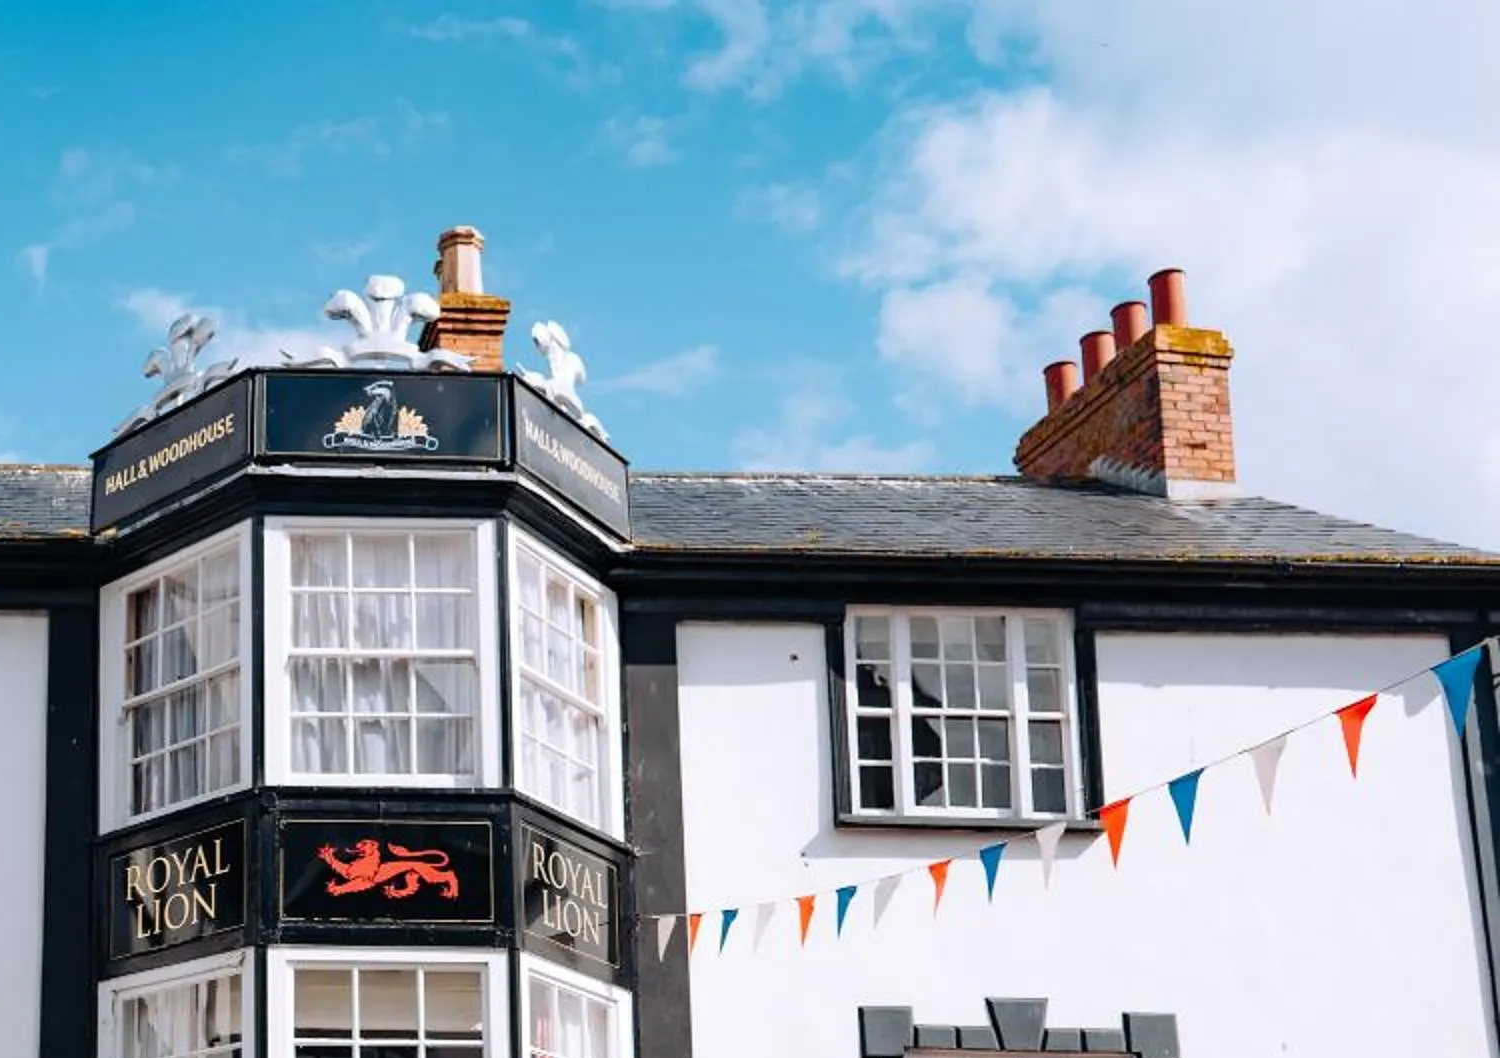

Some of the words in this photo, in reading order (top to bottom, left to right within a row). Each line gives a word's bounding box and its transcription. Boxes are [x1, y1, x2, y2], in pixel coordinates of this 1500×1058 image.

[125, 838, 231, 901] ROYAL
[532, 841, 609, 910] ROYAL
[136, 883, 217, 939] LION
[542, 889, 599, 945] LION
